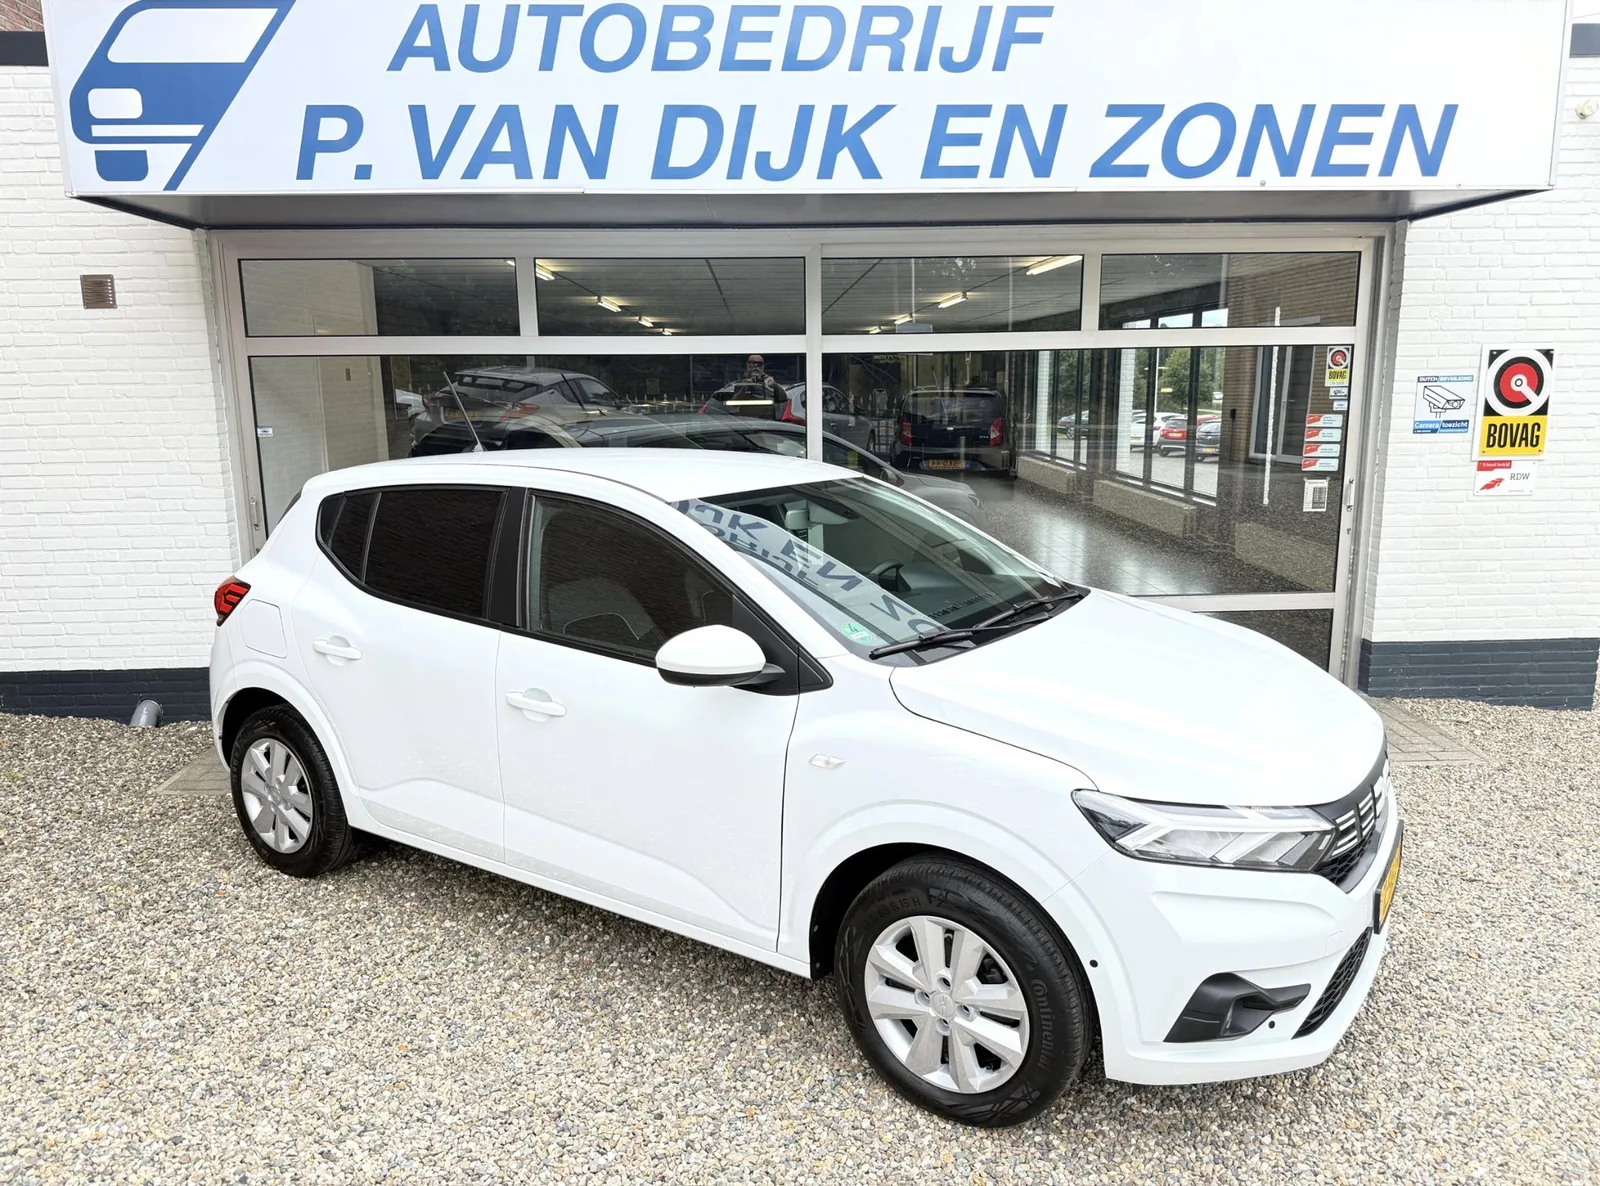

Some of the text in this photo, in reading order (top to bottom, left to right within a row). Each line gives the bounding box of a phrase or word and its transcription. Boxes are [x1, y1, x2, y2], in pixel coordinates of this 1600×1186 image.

[387, 4, 1053, 73] AUTOBEDRIJF
[296, 102, 1459, 181] P. VAN DIJK EN ZONEN
[1328, 370, 1347, 380] BOVAG
[1486, 422, 1541, 448] BOVAG
[1510, 473, 1530, 481] RDW
[1031, 978, 1055, 1070] Continental
